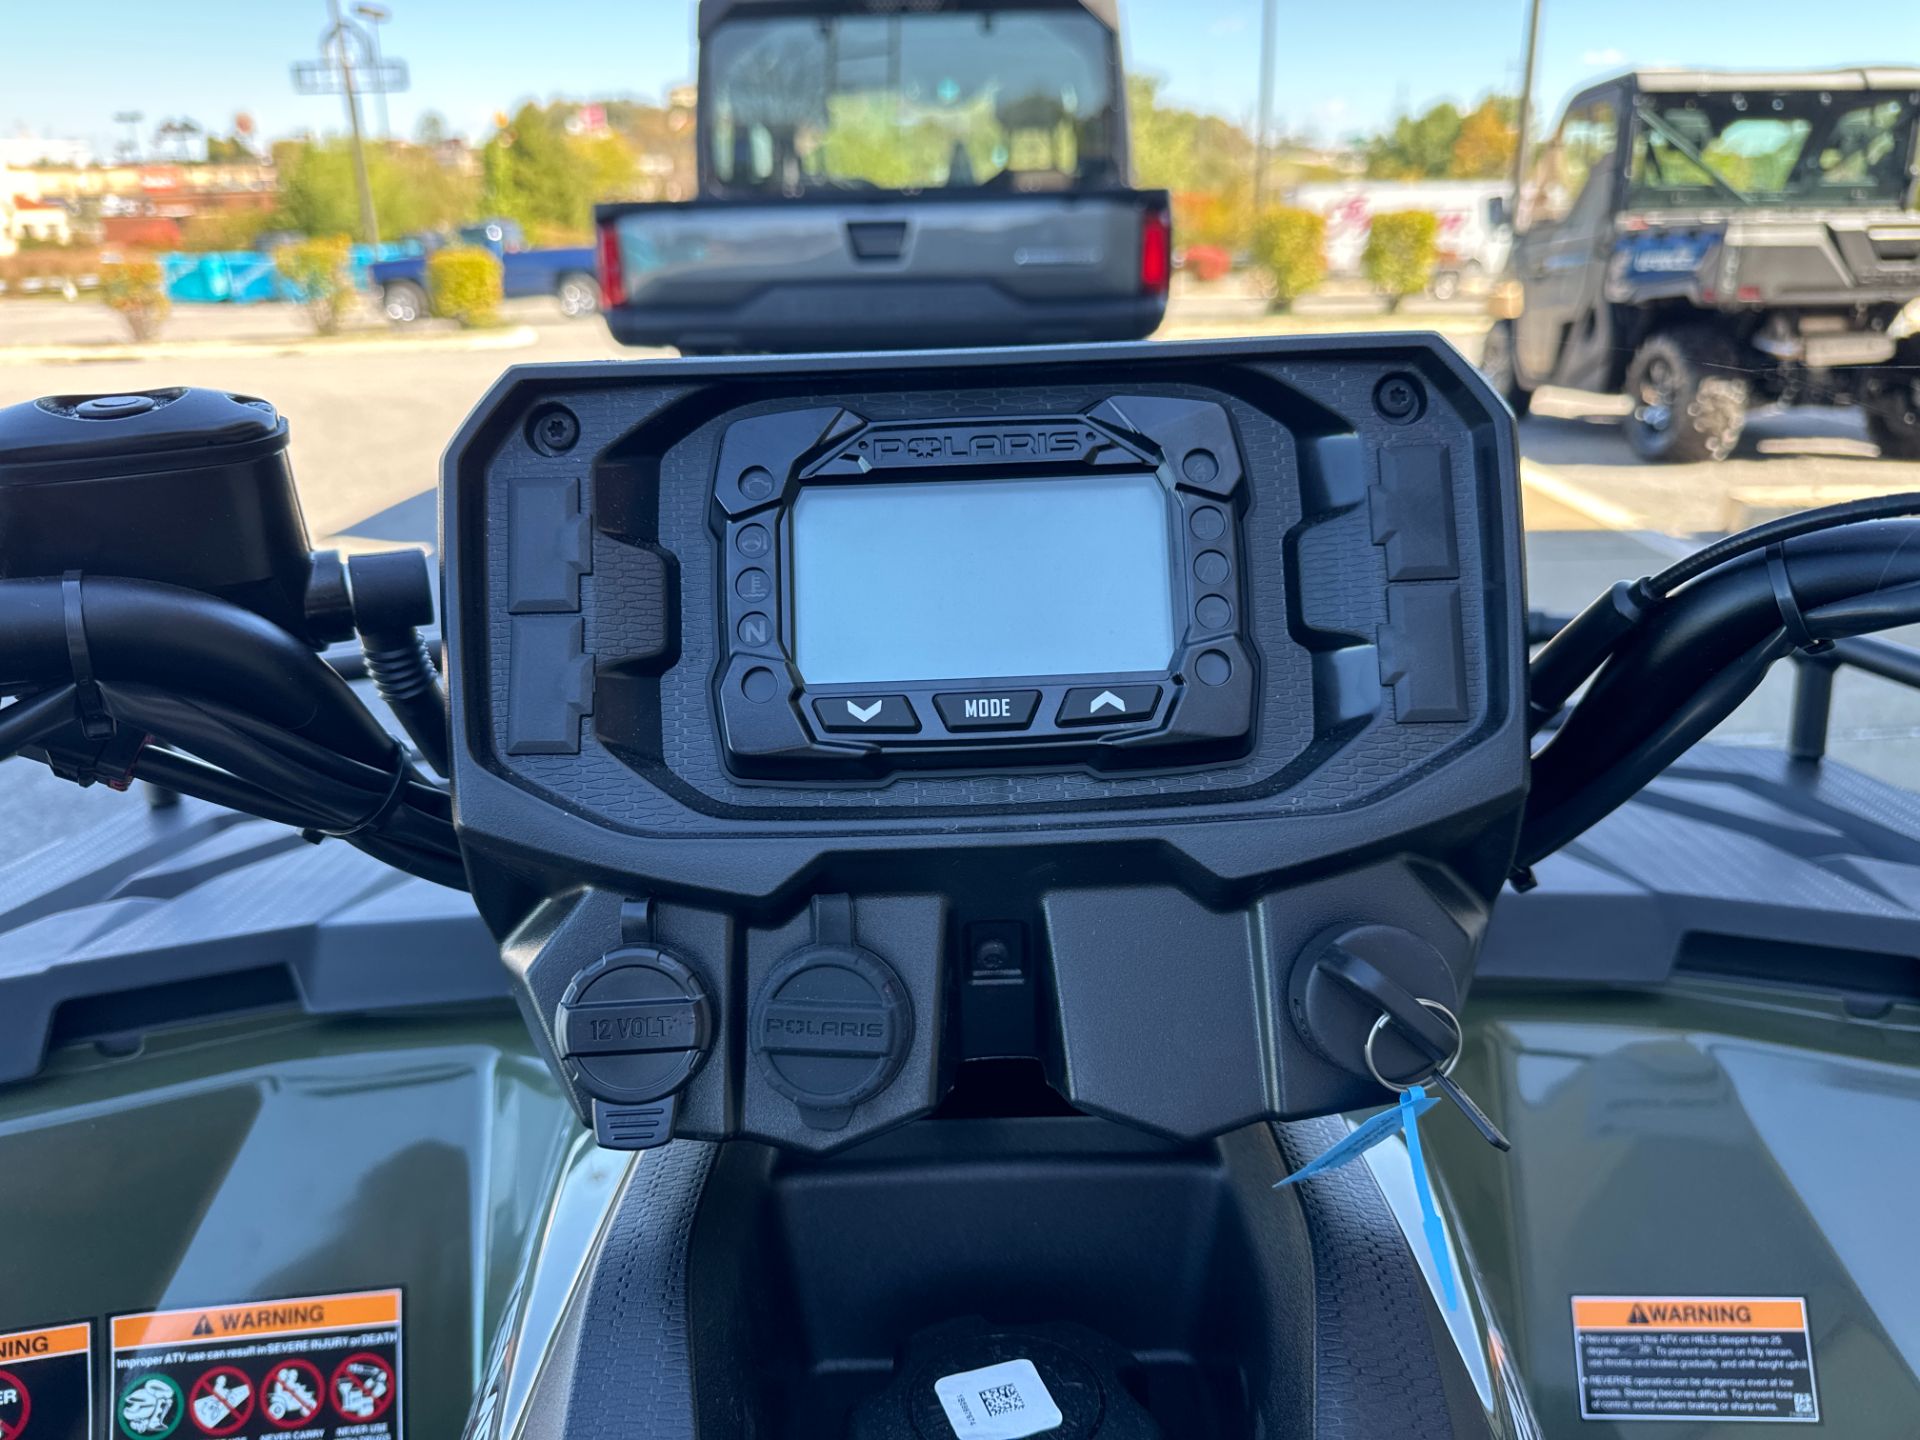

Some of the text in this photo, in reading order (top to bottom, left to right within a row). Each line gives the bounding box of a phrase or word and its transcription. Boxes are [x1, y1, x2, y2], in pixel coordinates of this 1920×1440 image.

[873, 431, 1081, 460] POLARIS
[745, 620, 766, 642] N
[965, 698, 1011, 718] MODE
[590, 1015, 673, 1041] 12 VOLT
[766, 1018, 884, 1038] POLARIS
[221, 1304, 325, 1331] WARNING
[1648, 1305, 1752, 1323] WARNING
[0, 1336, 49, 1358] ING
[116, 1355, 164, 1370] Improper
[163, 1352, 187, 1364] ATV
